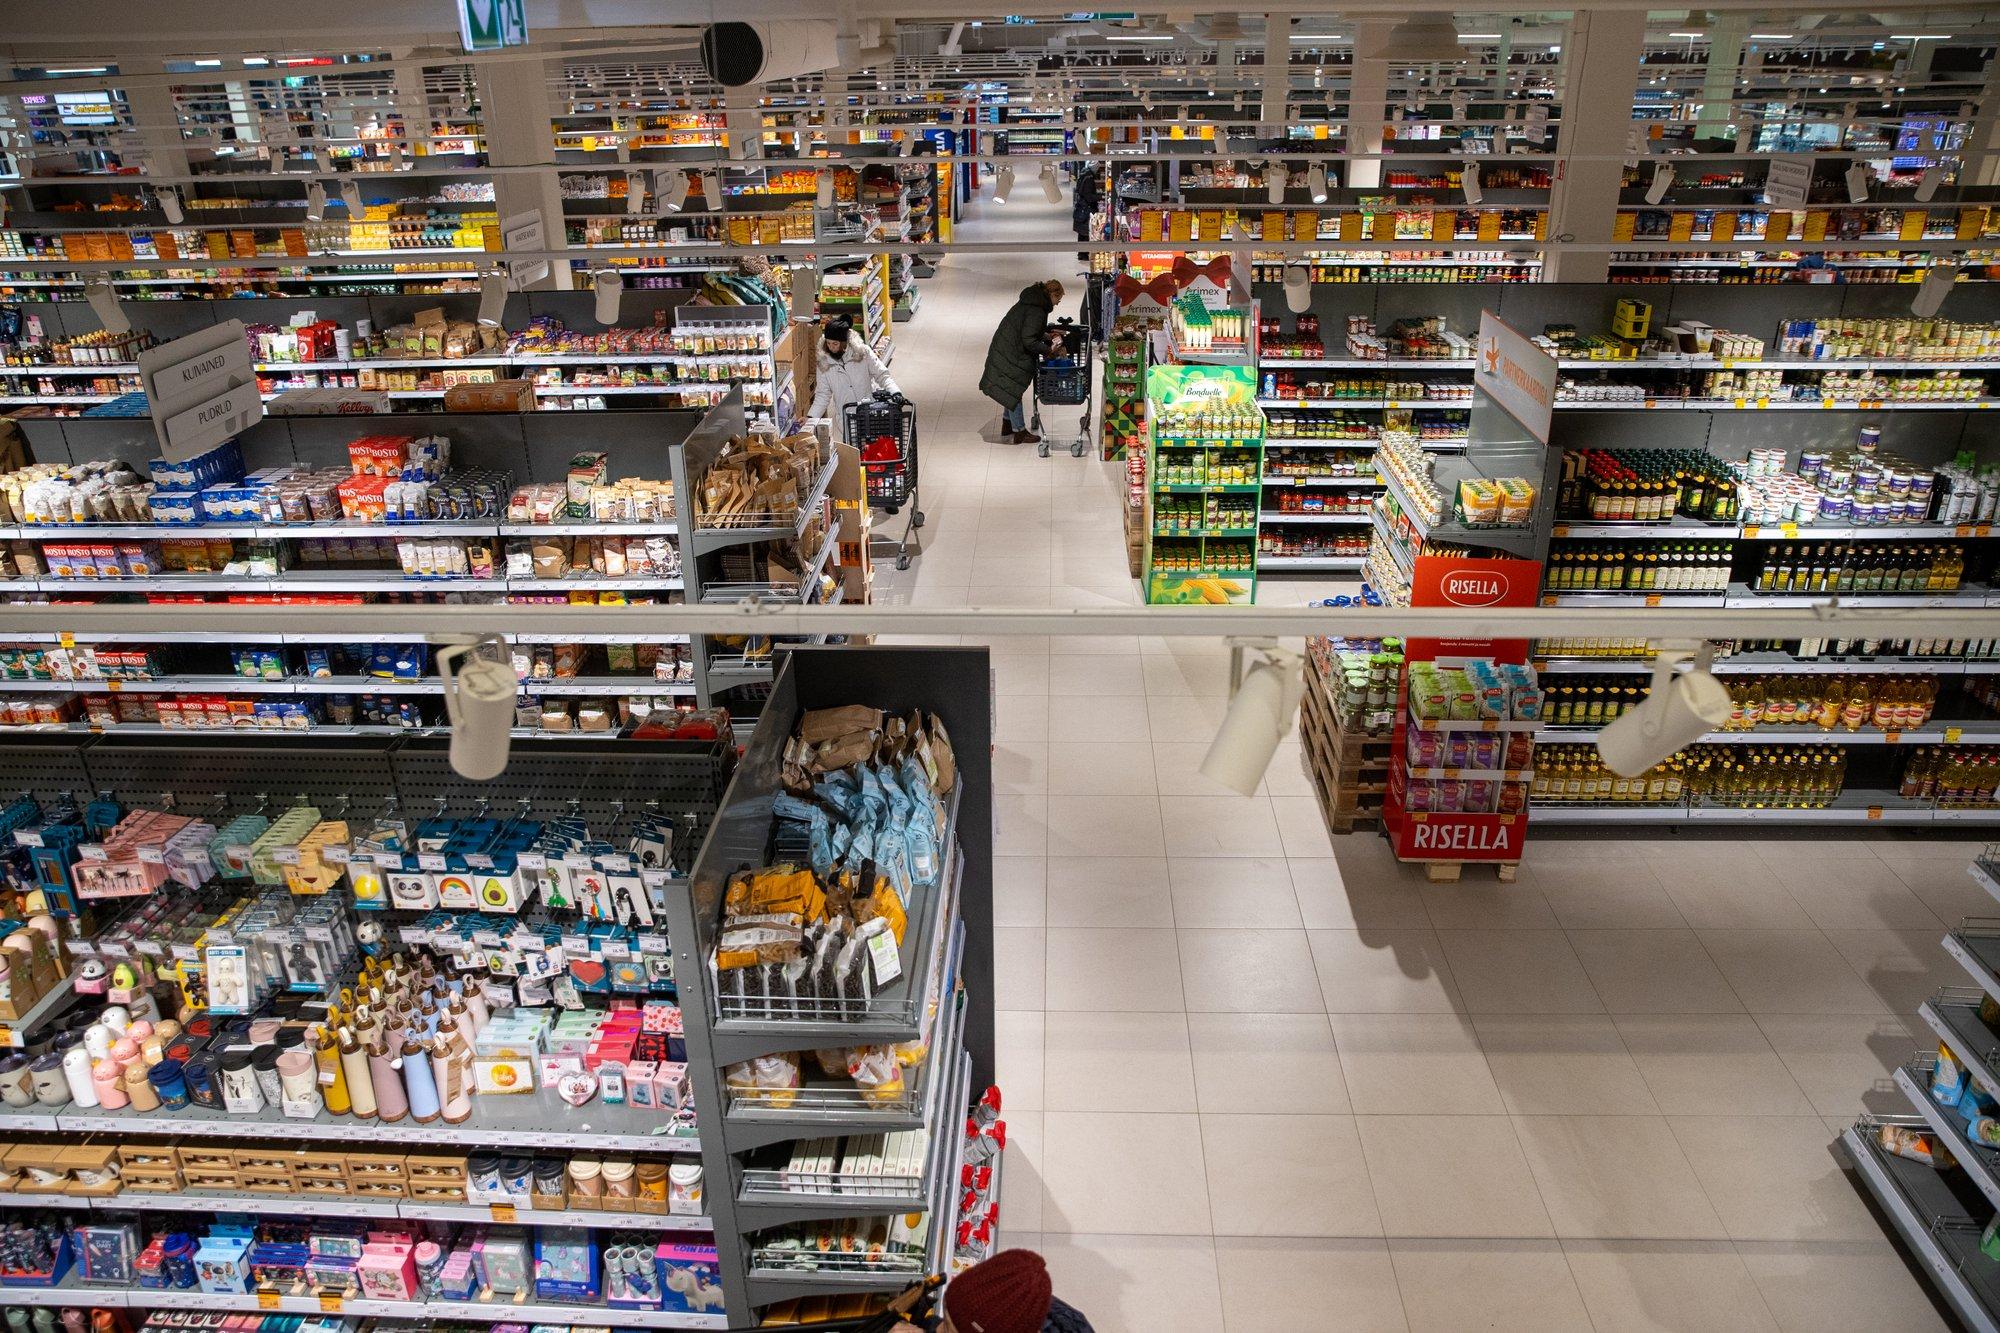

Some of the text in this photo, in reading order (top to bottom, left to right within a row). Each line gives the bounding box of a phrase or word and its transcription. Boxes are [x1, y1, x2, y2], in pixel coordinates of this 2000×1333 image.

[182, 355, 225, 382] KUIVAINED
[1185, 388, 1222, 397] Bonduelle
[198, 400, 232, 424] PUDRUD
[372, 448, 399, 457] BOSTO
[357, 494, 383, 503] BOSTO
[44, 548, 67, 556] BOSTO
[67, 548, 90, 556] BOSTO
[92, 548, 114, 556] BOSTO
[1449, 580, 1498, 595] RISELLA
[95, 656, 121, 665] BOSTO
[121, 656, 146, 665] BOSTO
[87, 698, 107, 706] BOSTO
[157, 702, 178, 711] BOSTO
[182, 702, 203, 711] BOSTO
[206, 703, 227, 711] BOSTO
[1414, 824, 1508, 850] RISELLA
[673, 1244, 717, 1254] COIN BAN
